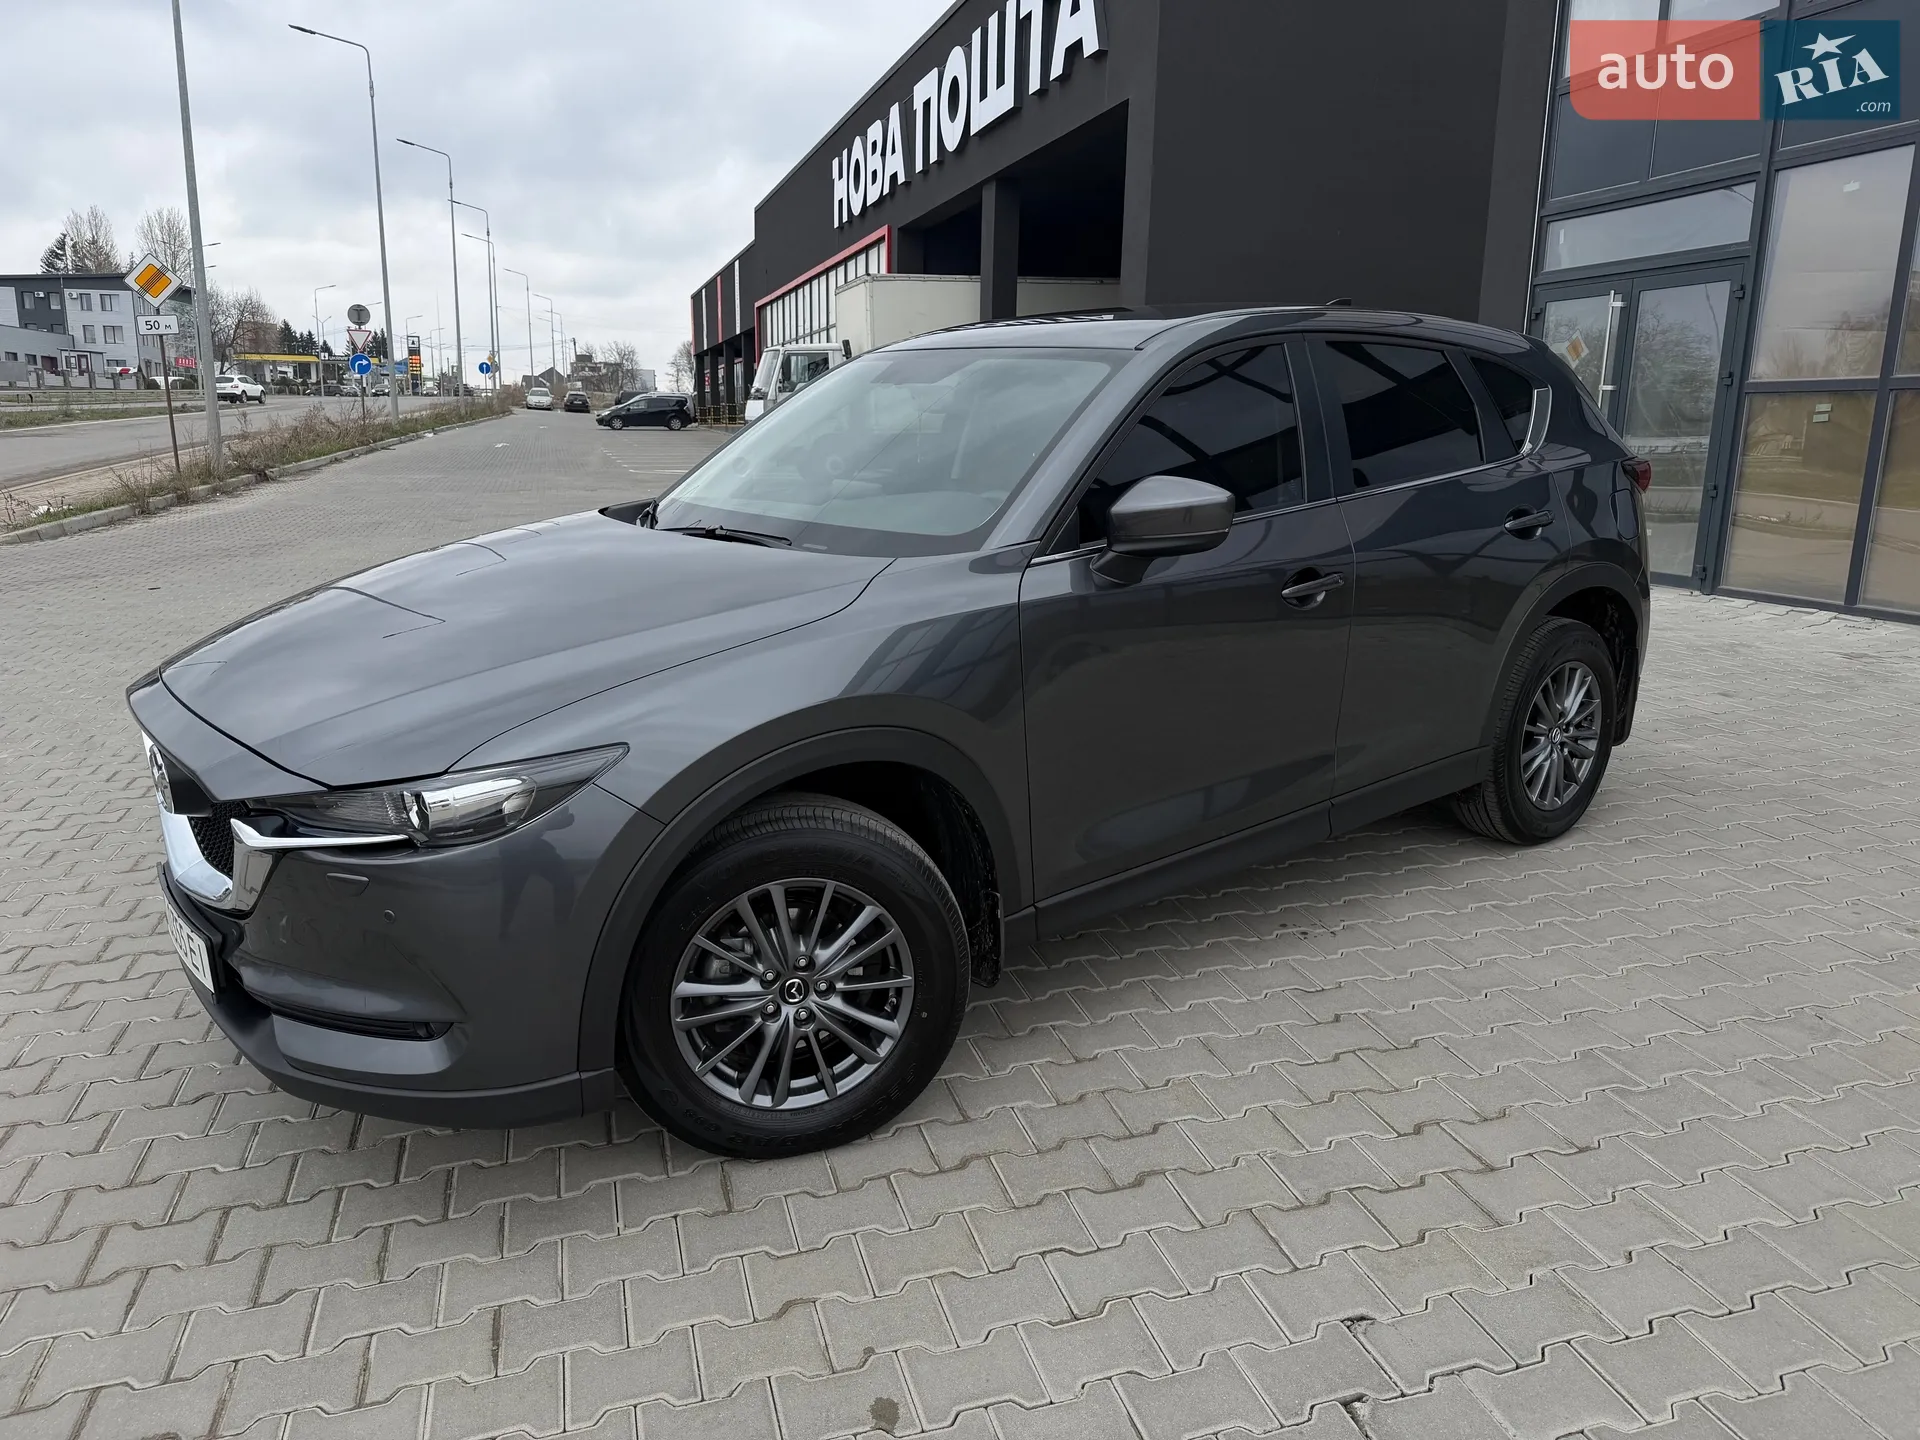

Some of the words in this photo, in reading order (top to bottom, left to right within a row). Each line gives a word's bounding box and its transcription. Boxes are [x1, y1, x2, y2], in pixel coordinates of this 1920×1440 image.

[831, 101, 909, 229] НОВА
[913, 0, 1104, 175] ПОШТА
[145, 320, 160, 331] 50
